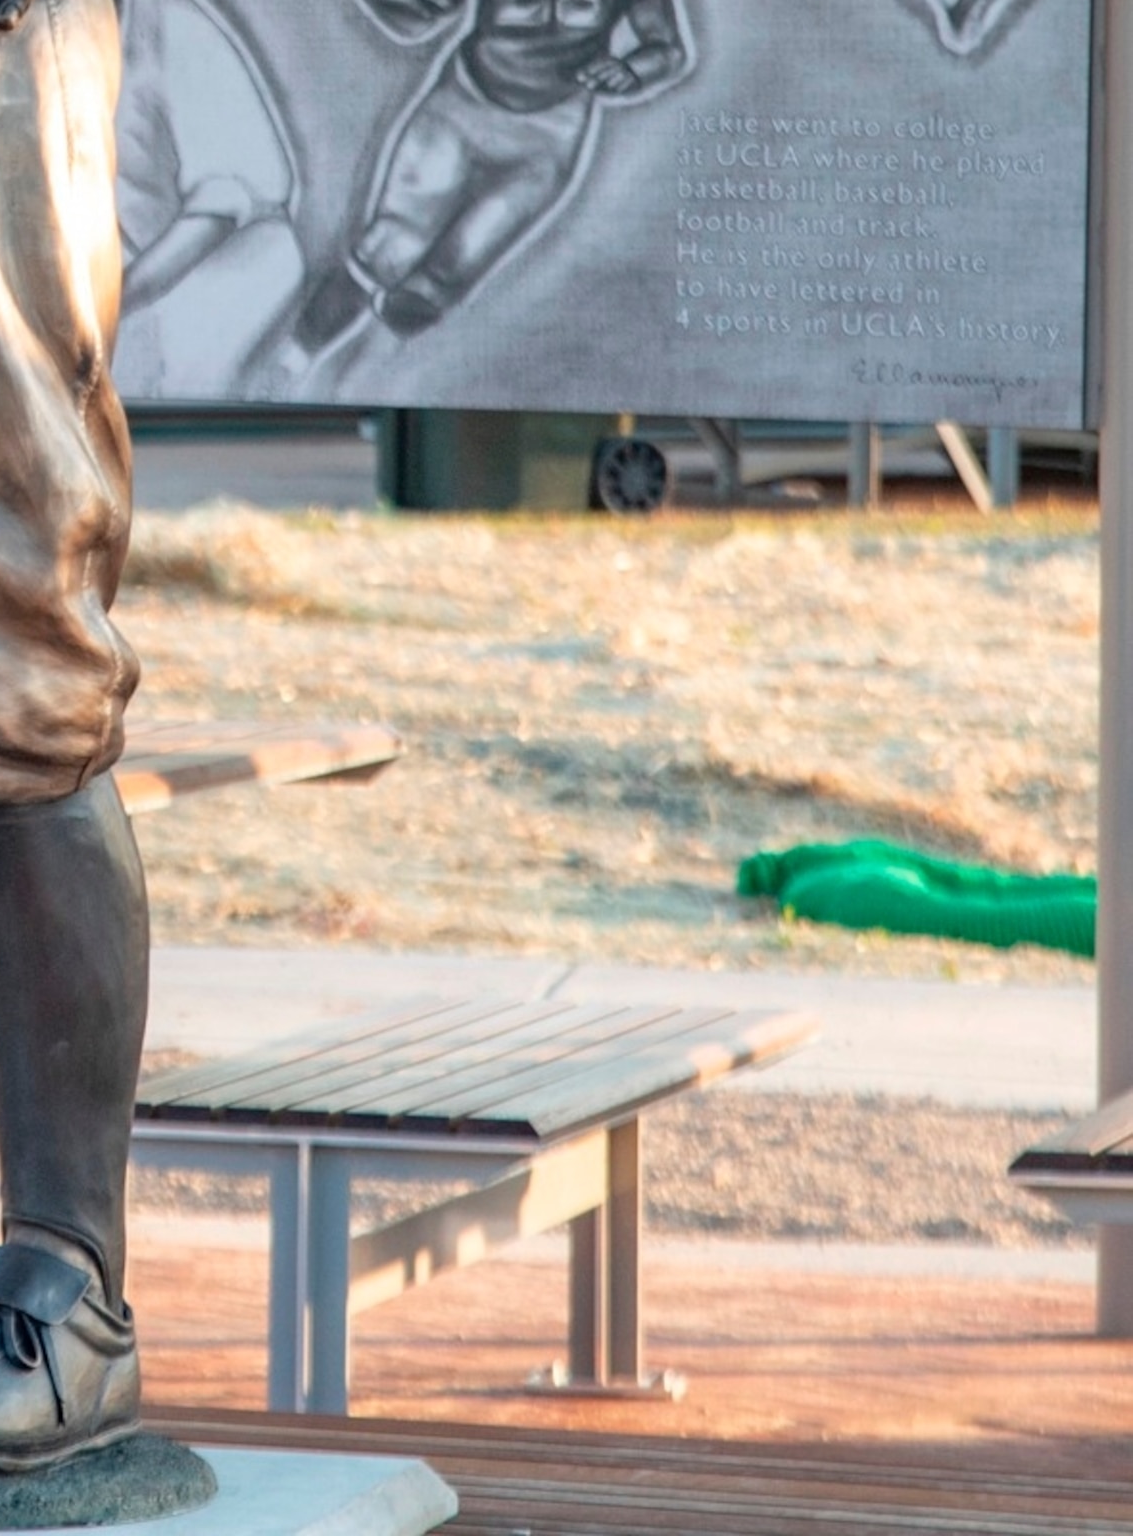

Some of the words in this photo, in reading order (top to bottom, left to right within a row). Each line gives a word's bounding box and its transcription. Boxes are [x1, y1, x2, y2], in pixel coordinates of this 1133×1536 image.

[678, 112, 758, 138] Jackie
[772, 116, 838, 137] went
[852, 120, 880, 138] to
[895, 116, 994, 146] college
[678, 148, 703, 165] at
[717, 144, 799, 167] UCLA
[814, 146, 899, 170] where
[913, 150, 944, 172] he
[958, 152, 1044, 178] played
[678, 175, 824, 202] basketball,
[835, 180, 954, 207] baseball,
[677, 209, 783, 233] football
[795, 216, 844, 235] and
[859, 216, 937, 238] track.
[677, 242, 714, 264] He
[729, 246, 747, 264] is
[762, 245, 805, 267] the
[819, 247, 876, 276] only
[889, 250, 987, 273] athlete
[676, 279, 704, 297] to
[719, 276, 777, 298] have
[791, 278, 903, 304] lettered
[917, 283, 940, 304] in
[676, 308, 689, 329] 4
[704, 313, 791, 336] sports
[806, 316, 828, 333] in
[842, 312, 946, 337] UCLA's
[959, 317, 1064, 349] history.
